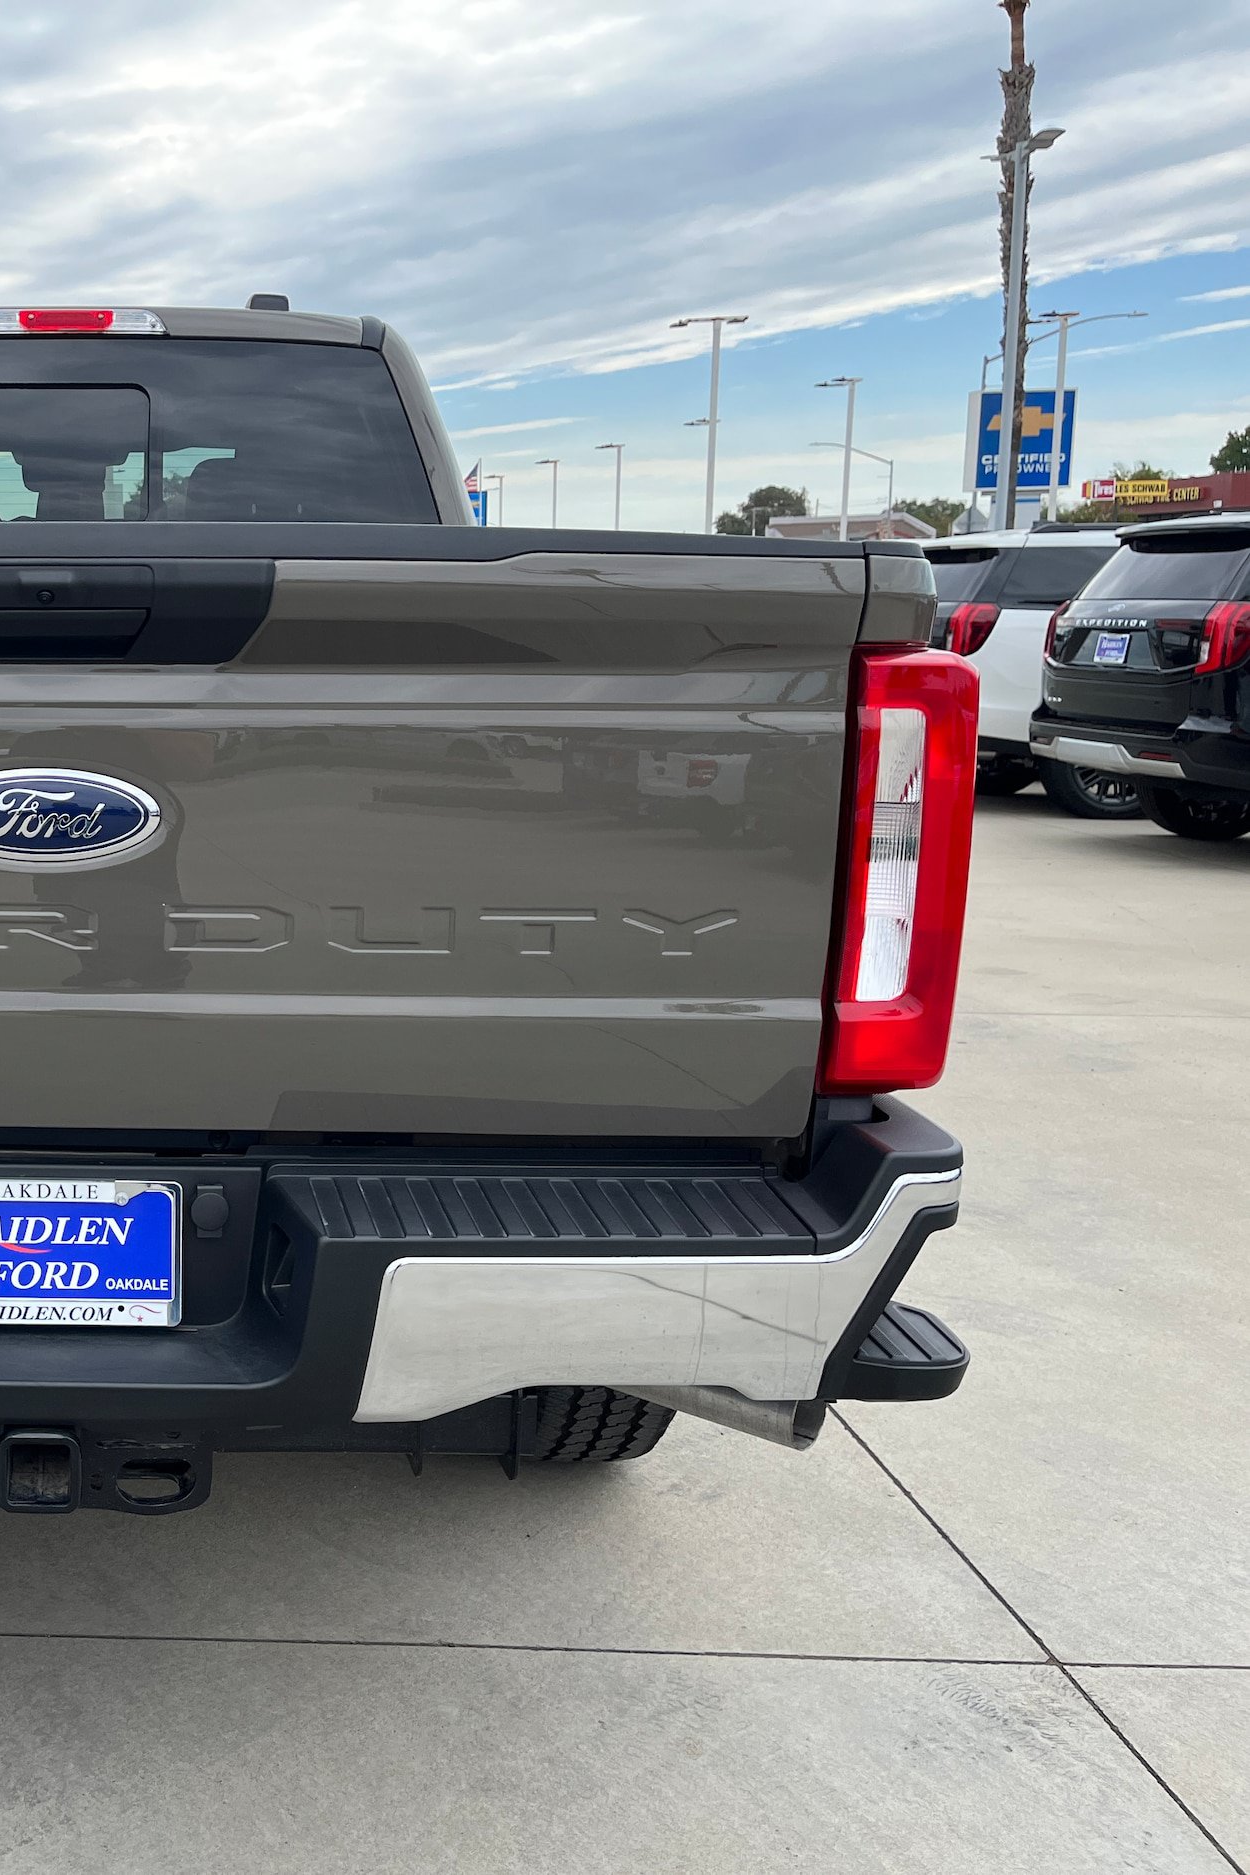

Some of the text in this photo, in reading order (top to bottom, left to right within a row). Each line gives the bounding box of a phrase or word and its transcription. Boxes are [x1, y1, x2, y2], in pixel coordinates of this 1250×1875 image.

[1132, 483, 1166, 493] SCHWAB
[1174, 487, 1200, 501] CENTER
[1076, 619, 1148, 627] EXPEDITION
[163, 903, 740, 956] DUTY
[105, 1278, 169, 1291] OAKDALE
